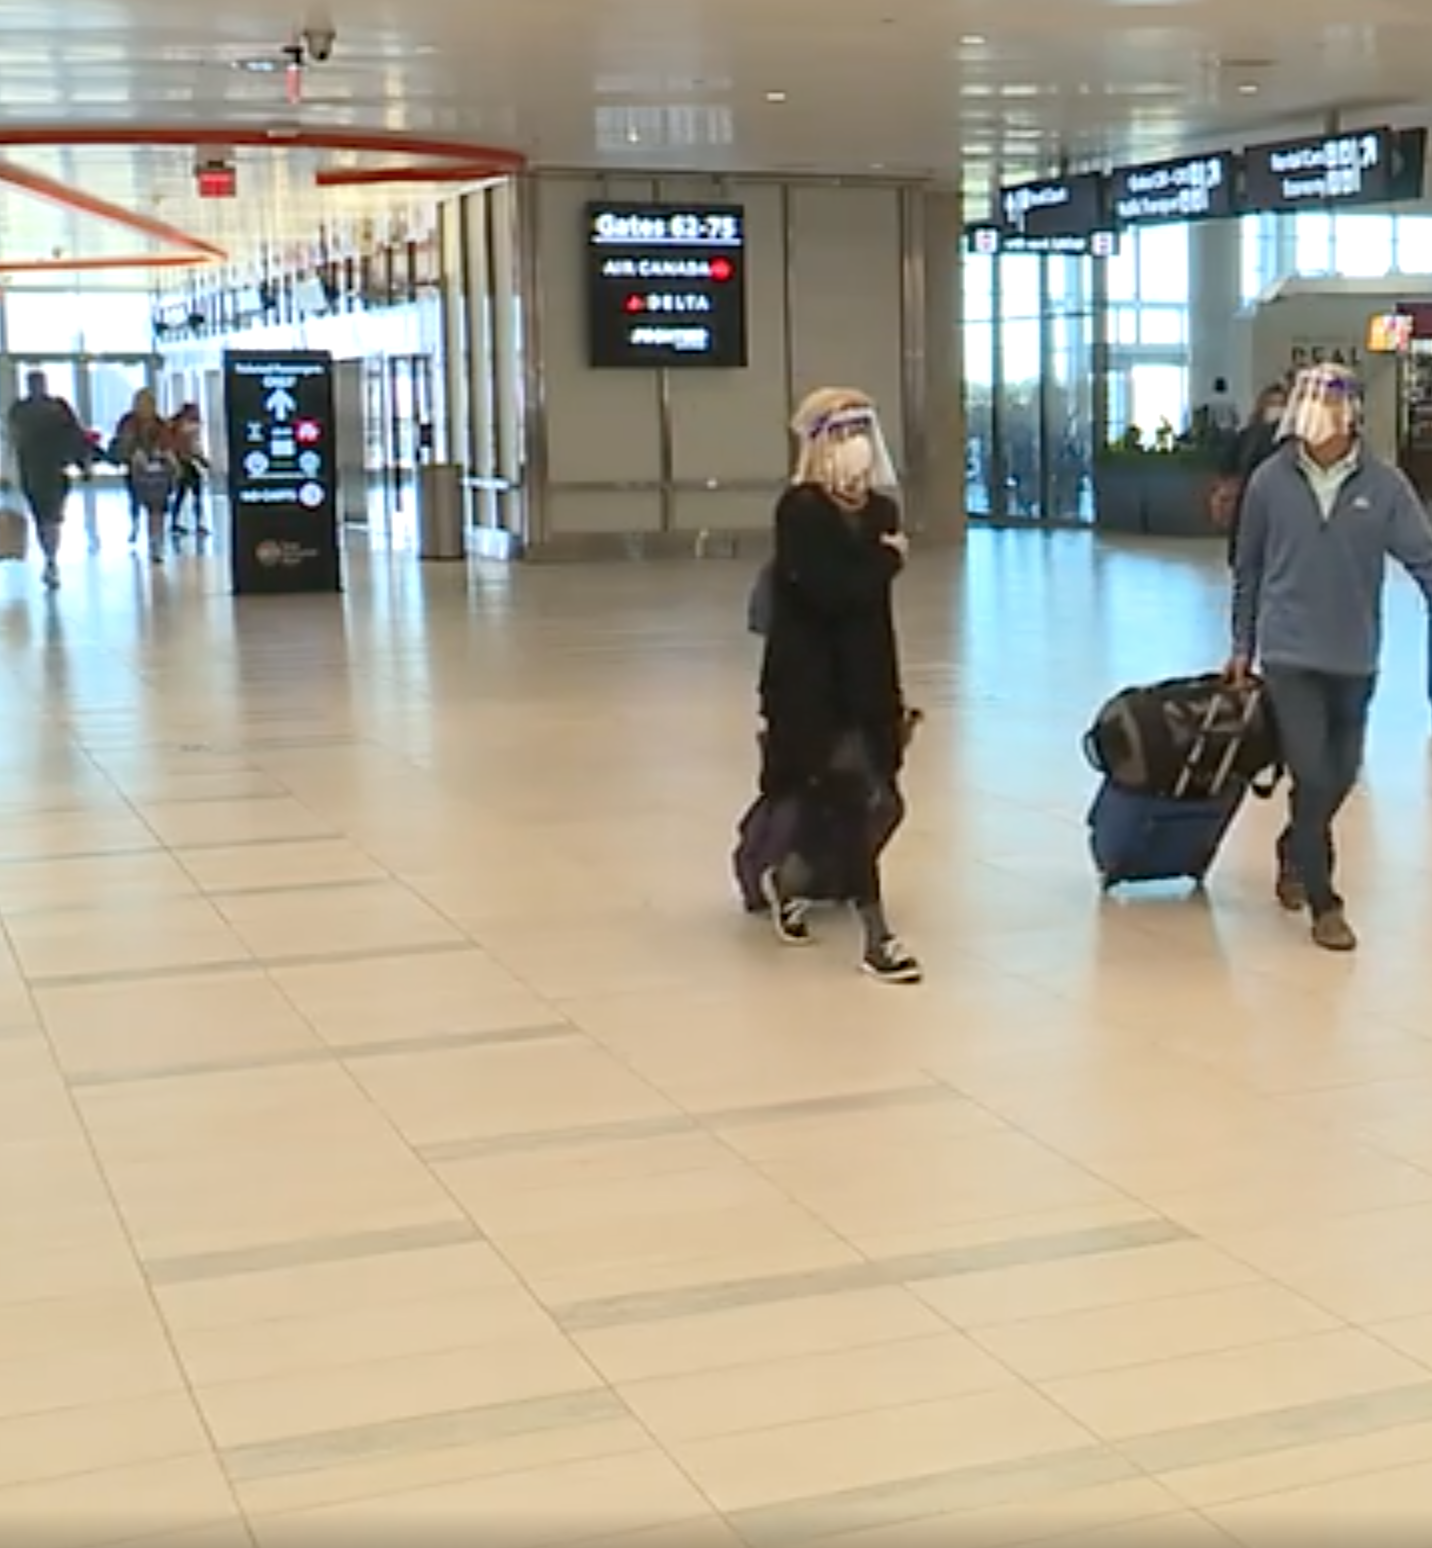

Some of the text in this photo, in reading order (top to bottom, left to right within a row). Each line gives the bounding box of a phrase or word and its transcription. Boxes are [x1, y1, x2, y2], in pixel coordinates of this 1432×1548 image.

[594, 212, 738, 238] Gates 62-75
[602, 260, 712, 277] AIR CANADA
[647, 294, 710, 311] DELTA
